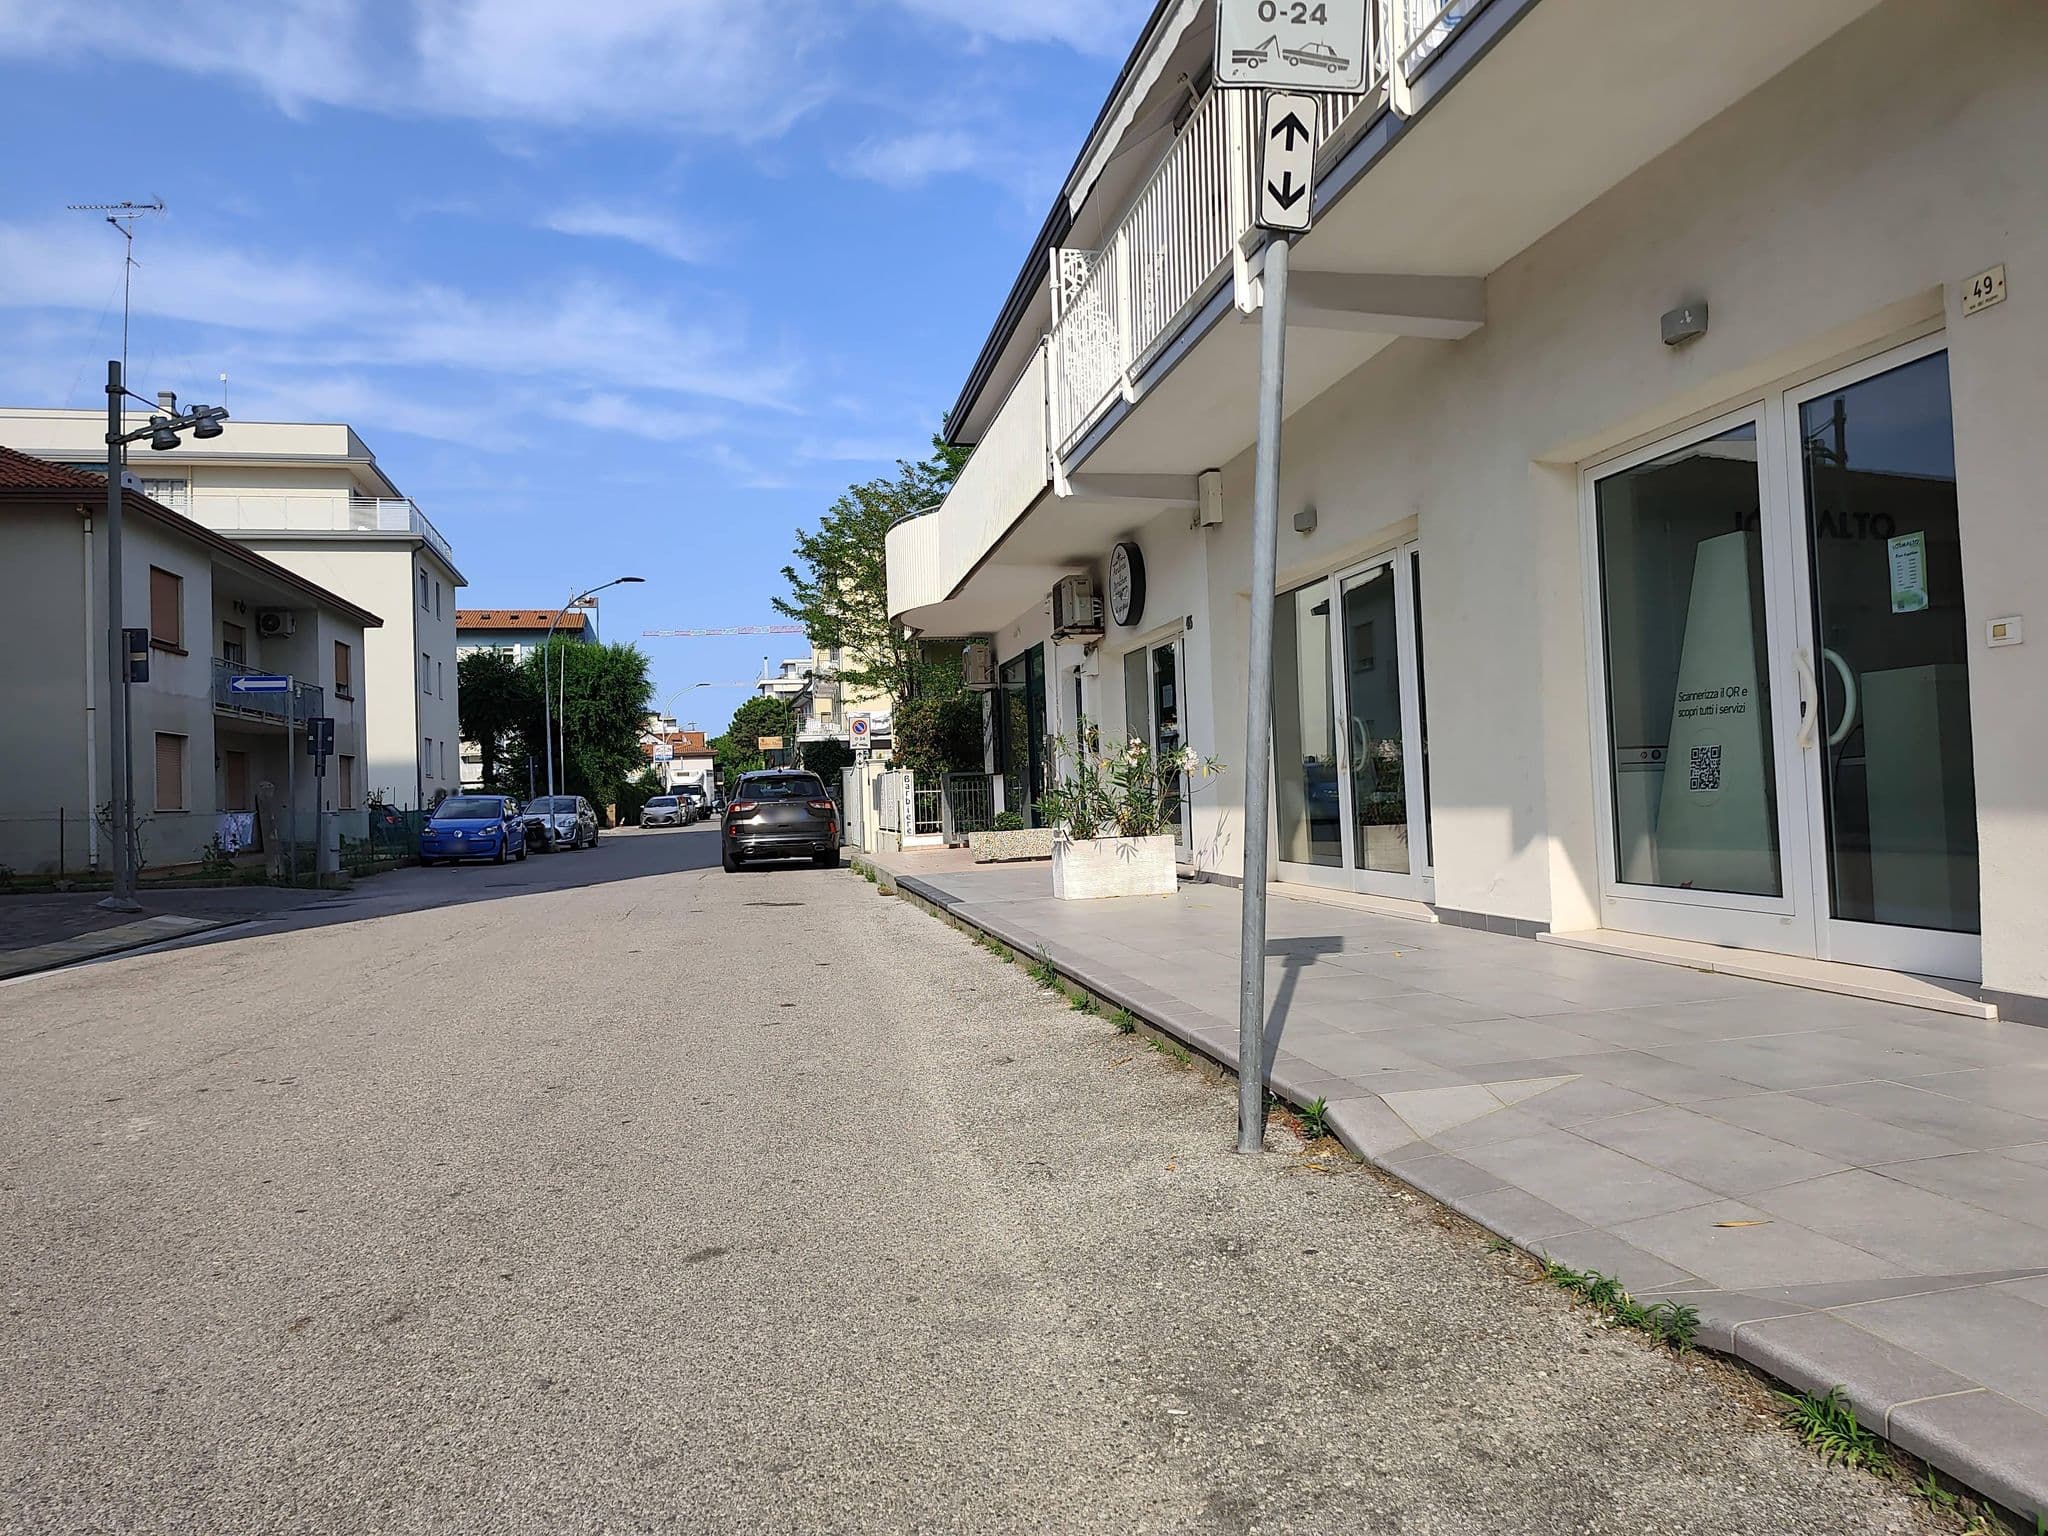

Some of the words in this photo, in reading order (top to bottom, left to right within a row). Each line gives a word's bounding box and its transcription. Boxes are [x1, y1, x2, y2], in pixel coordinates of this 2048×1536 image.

[1258, 0, 1328, 25] 0-24
[1974, 275, 1993, 298] 49
[1678, 689, 1719, 702] Scannerizza
[1720, 687, 1725, 698] il
[1726, 686, 1740, 698] QR
[1741, 688, 1748, 697] e
[1678, 705, 1698, 719] scopri
[1699, 704, 1715, 716] tutti
[1719, 702, 1746, 714] servizi
[904, 774, 912, 834] Barbiere
